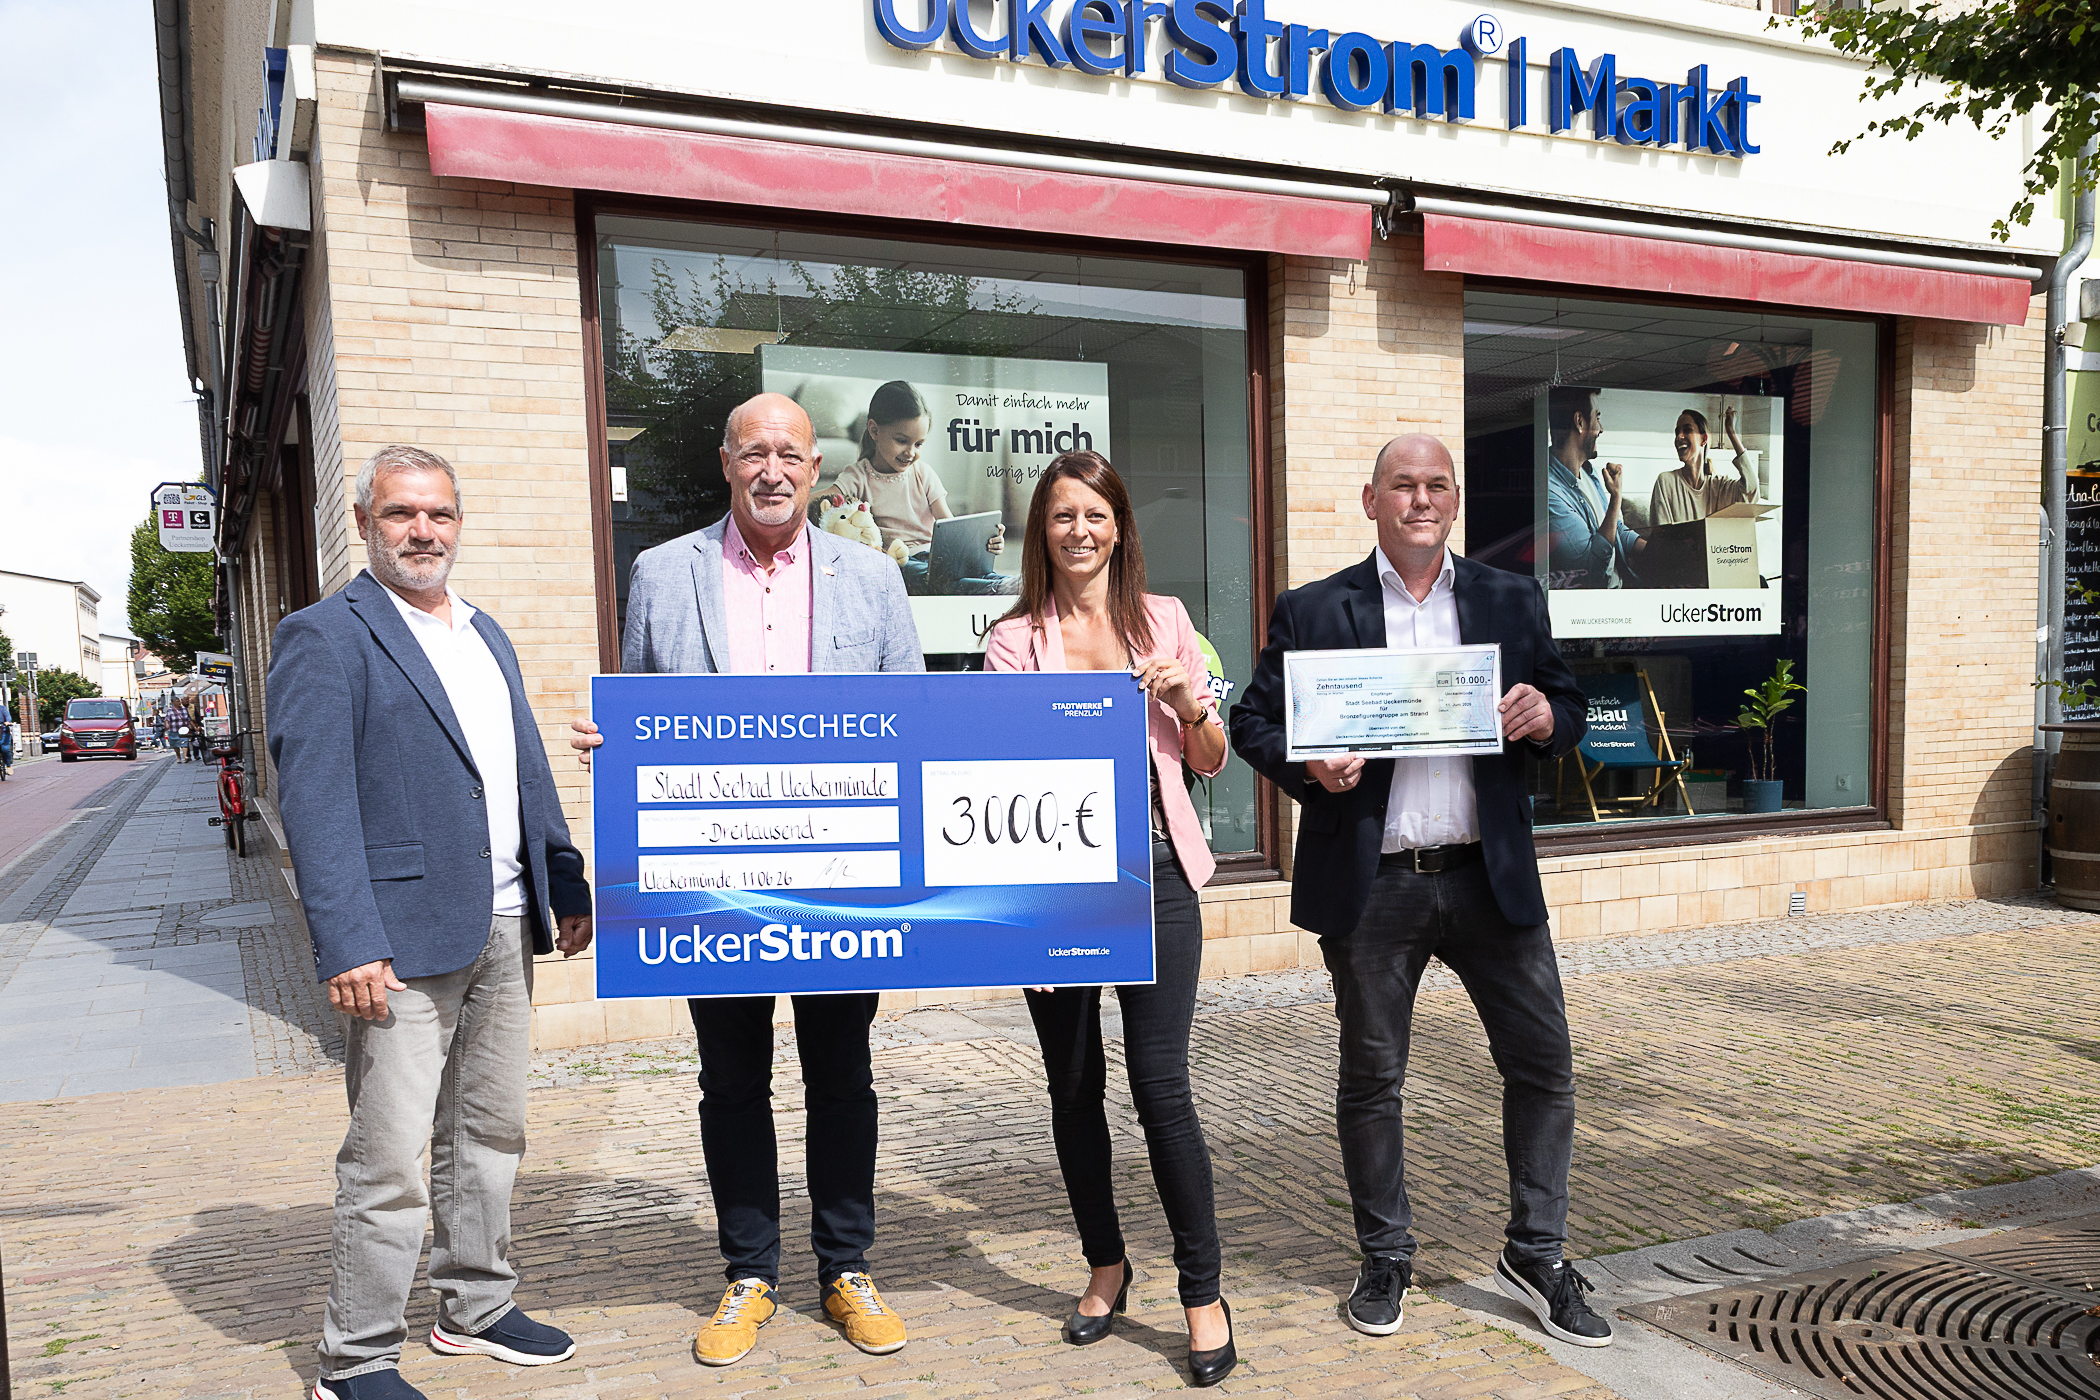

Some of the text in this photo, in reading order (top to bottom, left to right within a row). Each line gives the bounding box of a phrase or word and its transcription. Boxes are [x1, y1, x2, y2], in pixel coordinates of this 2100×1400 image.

[1551, 46, 1762, 160] Markt
[955, 392, 1090, 411] Damit einfach mehr
[946, 418, 1093, 455] für mich
[986, 464, 1024, 485] übrig
[1570, 617, 1632, 625] WWW.UCKERSTROM.DE
[1316, 682, 1363, 690] Zehntausend
[1051, 702, 1103, 710] STADTWERKE
[1588, 695, 1621, 706] Einfach
[1064, 709, 1103, 717] PRENZLAU
[1339, 712, 1399, 720] Bronzefigurengruppe
[1585, 706, 1628, 722] Blau
[634, 713, 898, 741] SPENDENSCHECK
[709, 770, 771, 800] Seebad
[780, 767, 888, 798] Ueckermünde
